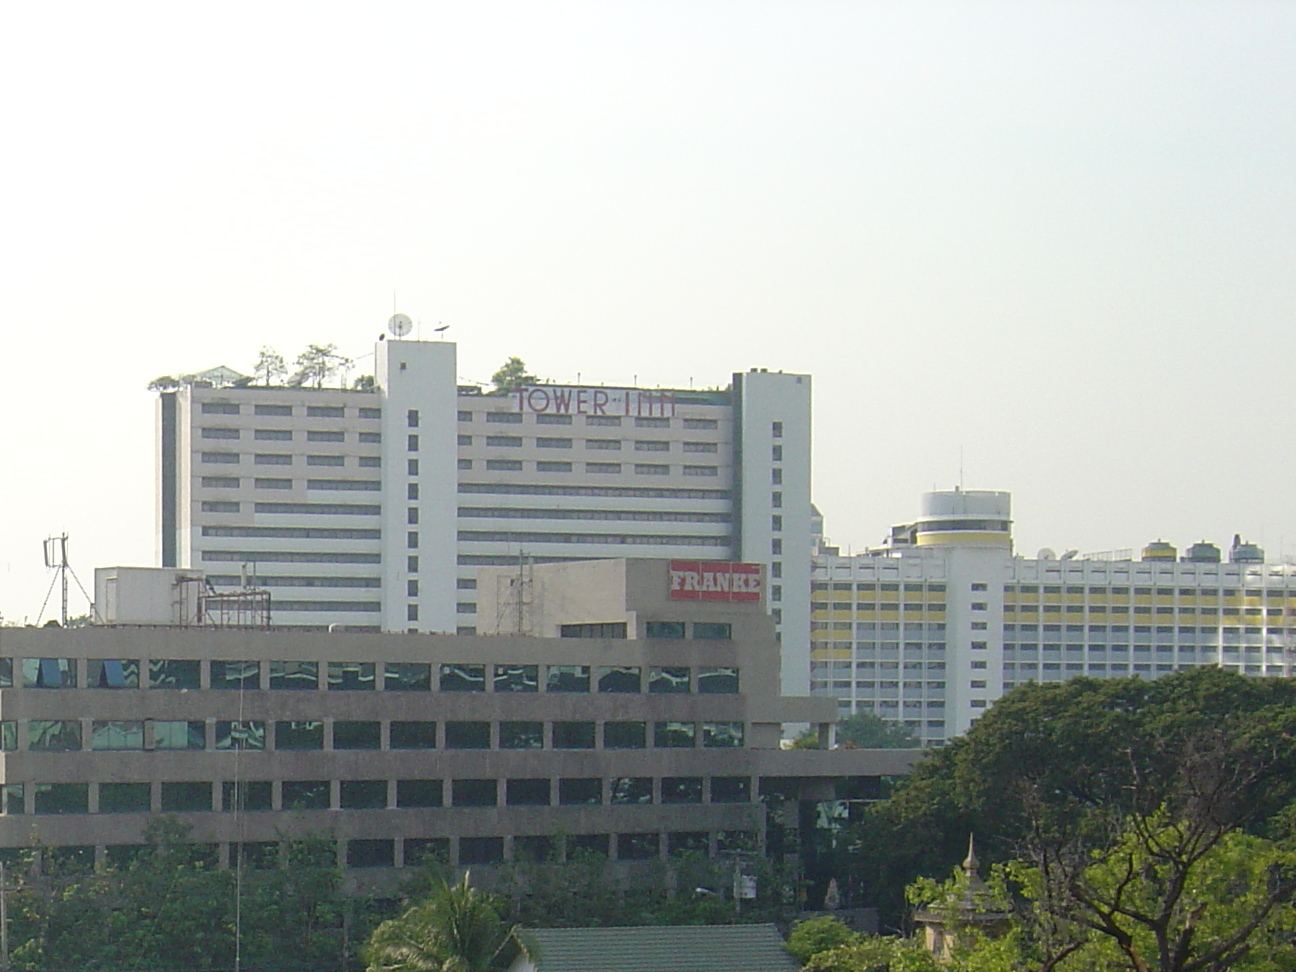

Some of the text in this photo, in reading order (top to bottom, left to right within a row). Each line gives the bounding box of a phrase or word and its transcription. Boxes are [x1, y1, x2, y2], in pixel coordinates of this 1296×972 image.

[513, 387, 676, 417] TOWER INN
[671, 570, 761, 592] FRANKE
